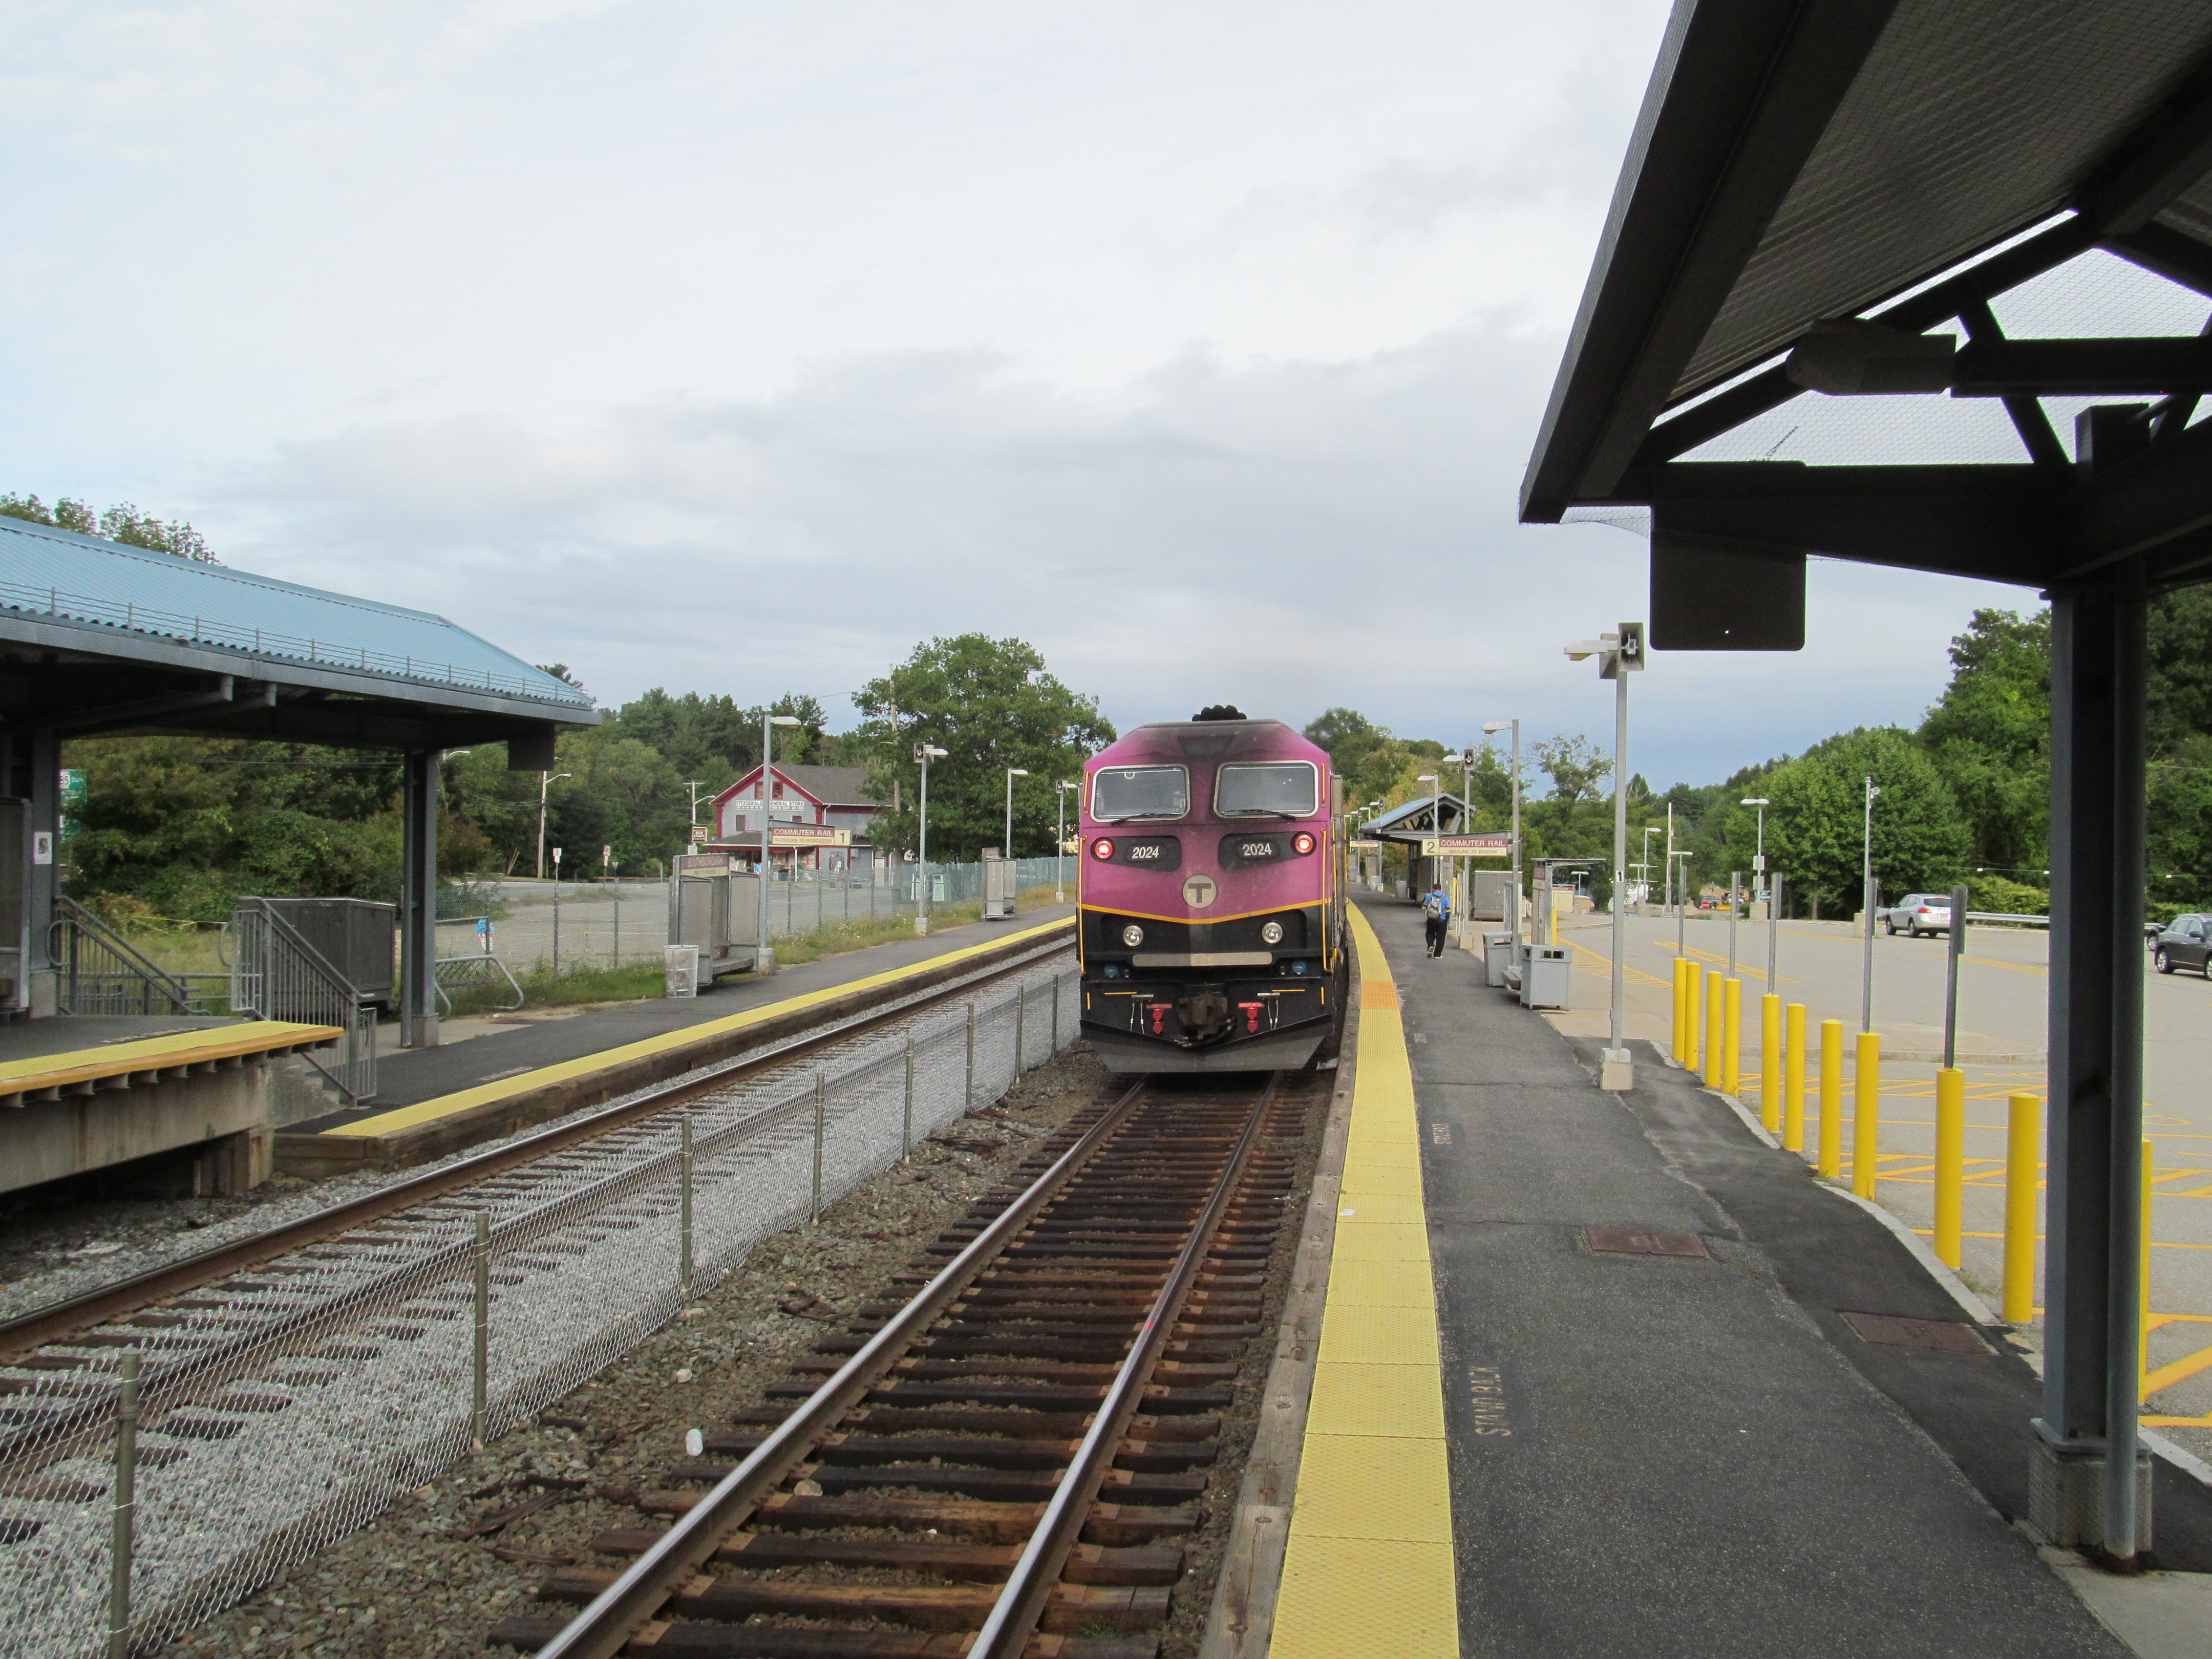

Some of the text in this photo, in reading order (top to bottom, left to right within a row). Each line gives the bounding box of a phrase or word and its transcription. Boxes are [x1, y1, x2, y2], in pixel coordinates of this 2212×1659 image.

[840, 832, 845, 843] 1
[1131, 846, 1159, 859] 2024
[1242, 843, 1272, 856] 2024
[1427, 841, 1435, 853] 2
[1617, 871, 1622, 882] 1
[1187, 883, 1211, 903] T
[1472, 1397, 1512, 1436] STAND
